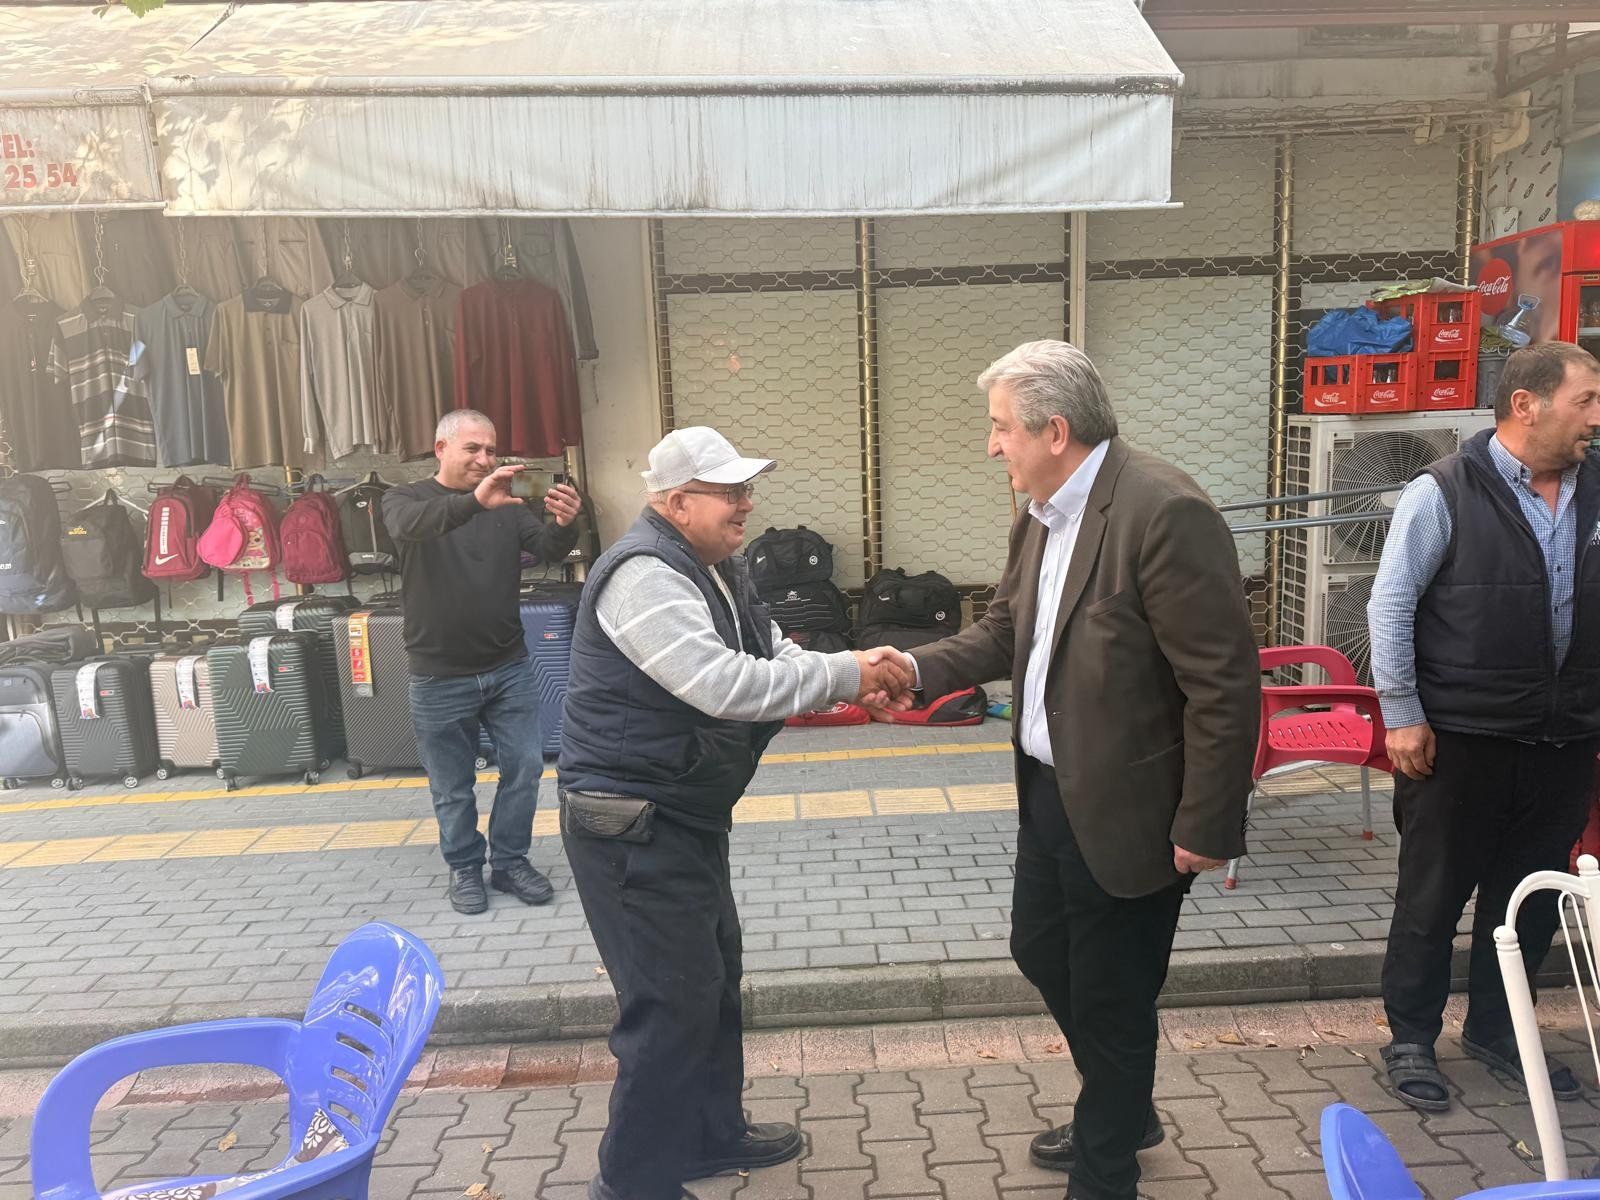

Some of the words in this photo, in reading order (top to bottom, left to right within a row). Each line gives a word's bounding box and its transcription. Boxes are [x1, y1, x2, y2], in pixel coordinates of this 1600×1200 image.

[0, 134, 35, 158] EL:
[5, 164, 38, 189] 25
[47, 162, 78, 188] 54
